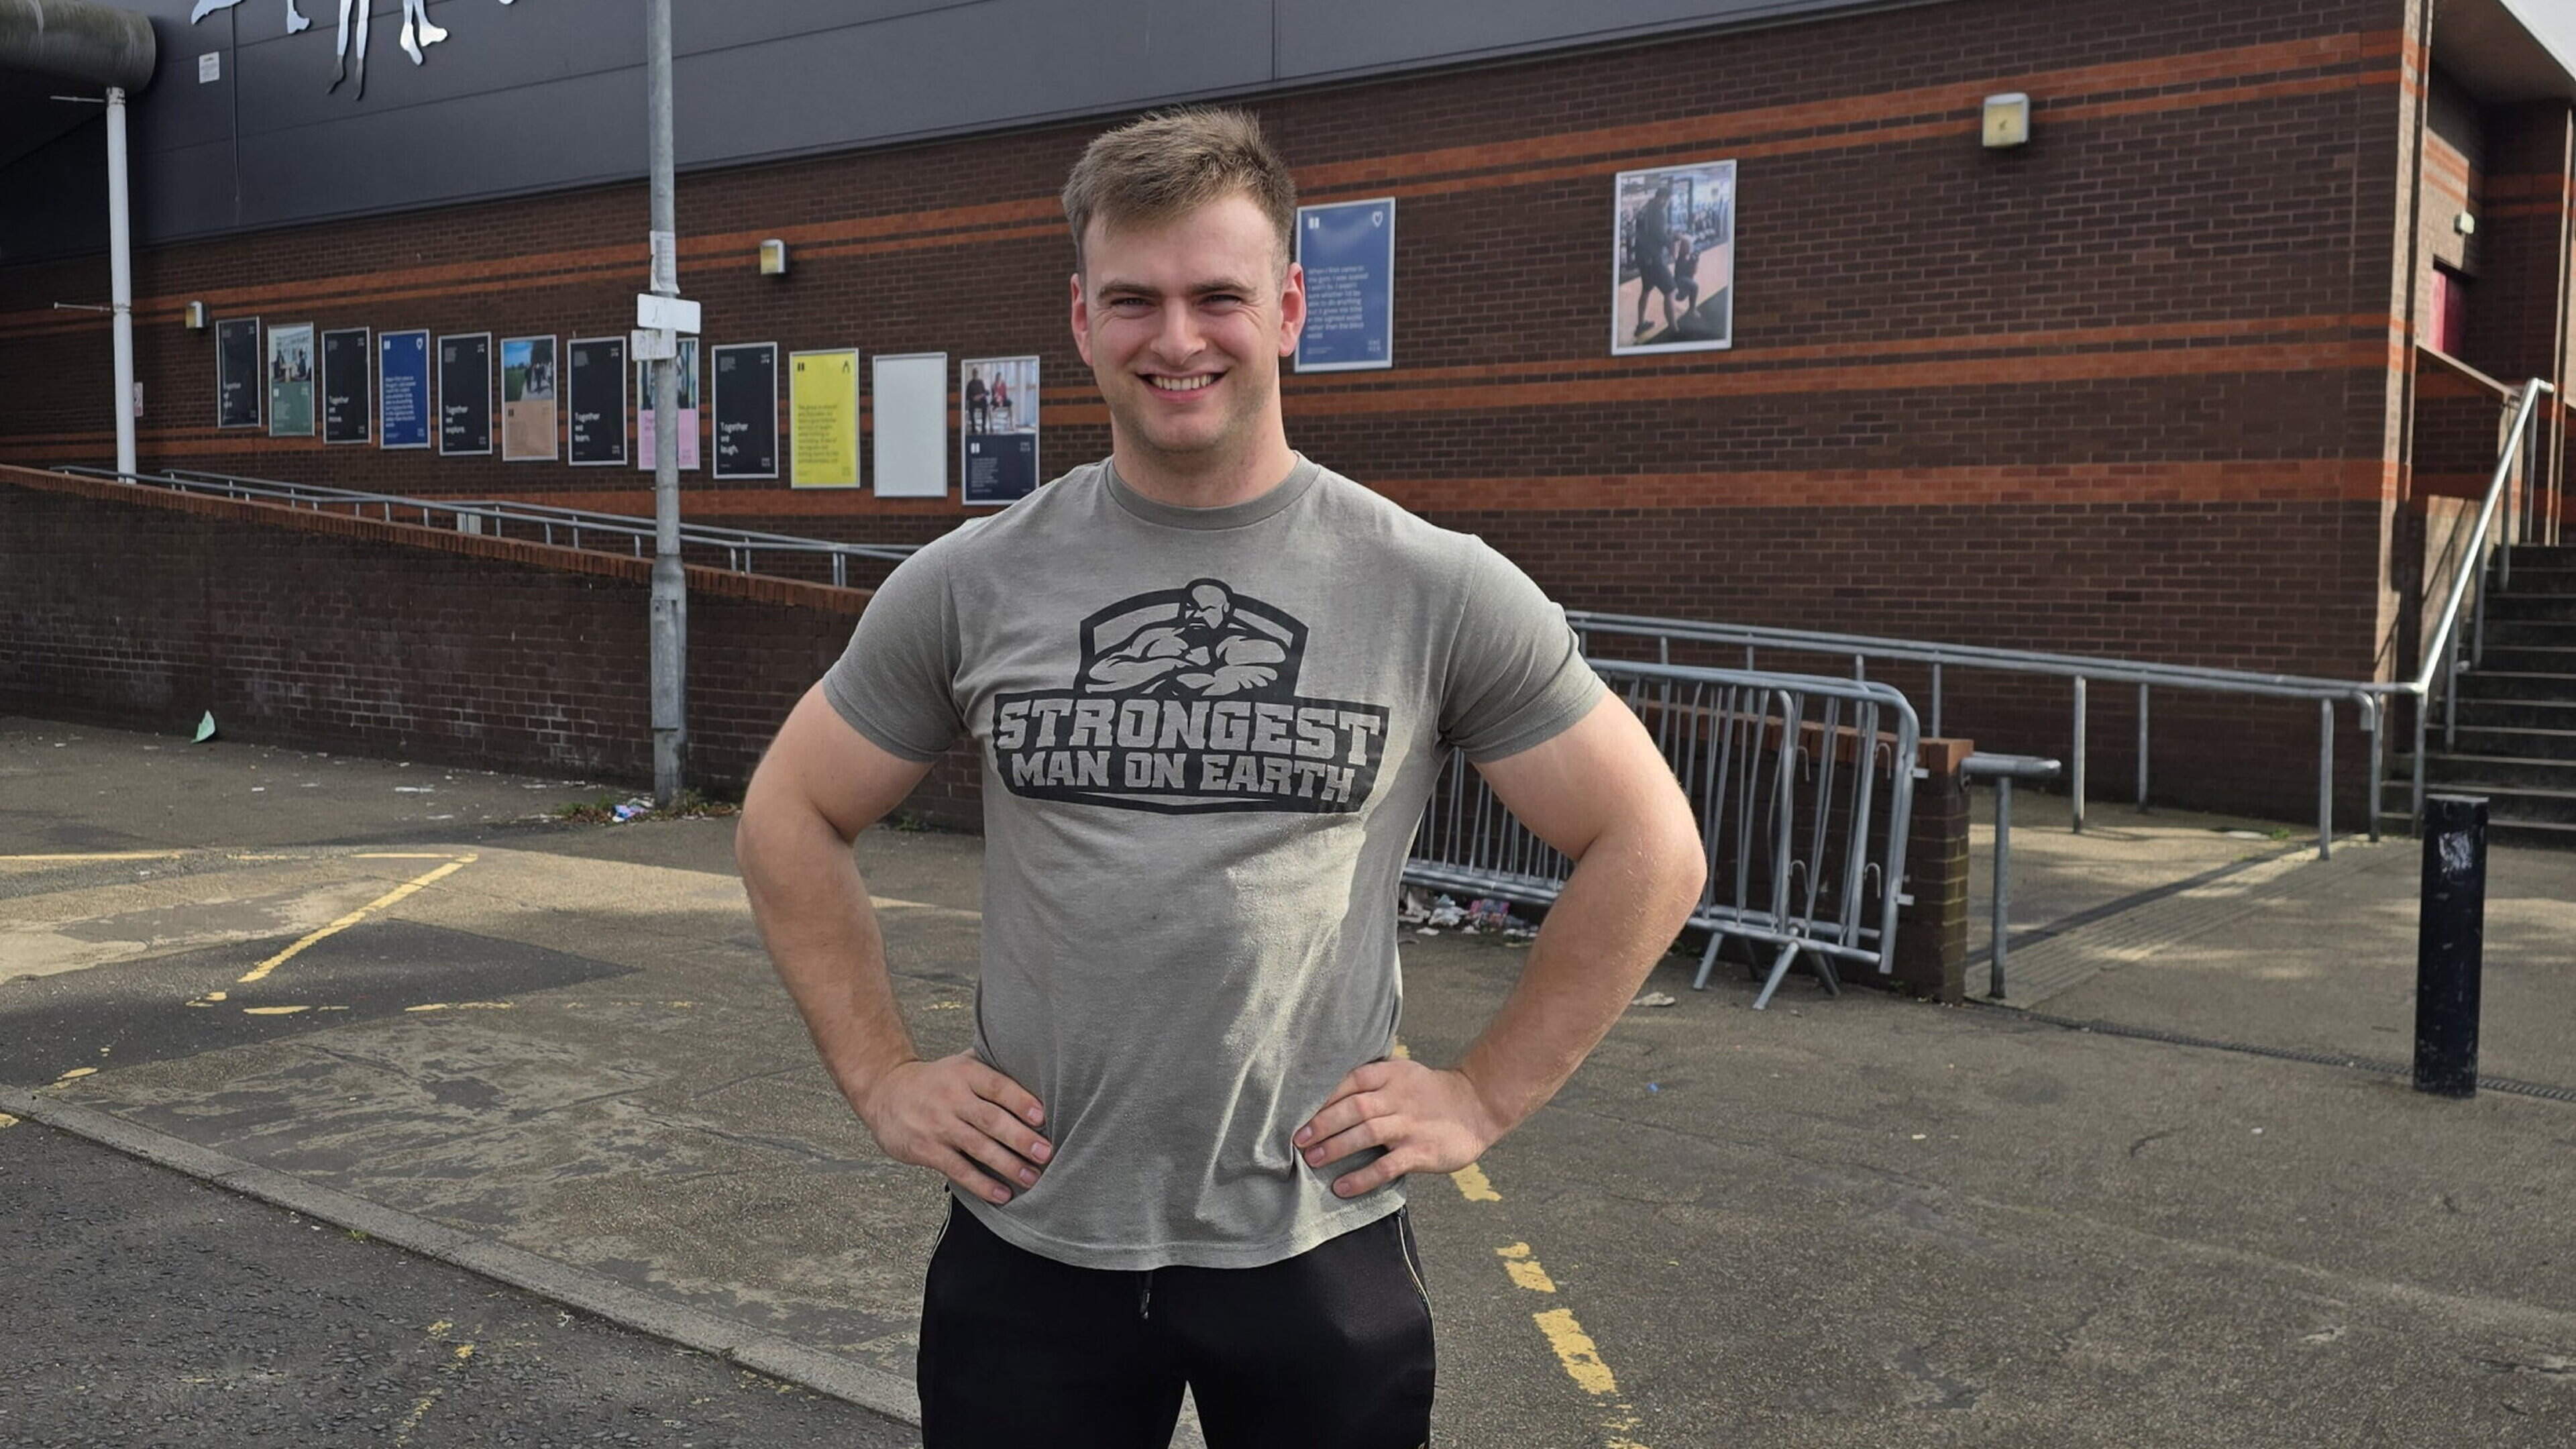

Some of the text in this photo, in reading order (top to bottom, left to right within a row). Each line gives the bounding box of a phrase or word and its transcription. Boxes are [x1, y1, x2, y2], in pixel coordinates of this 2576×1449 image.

[329, 395, 350, 405] Together
[445, 405, 469, 416] Together
[574, 412, 601, 423] Together
[720, 421, 749, 434] Together
[720, 435, 730, 443] we
[998, 698, 1381, 766] STRONGEST
[1011, 750, 1355, 804] MAN ON EARTH
